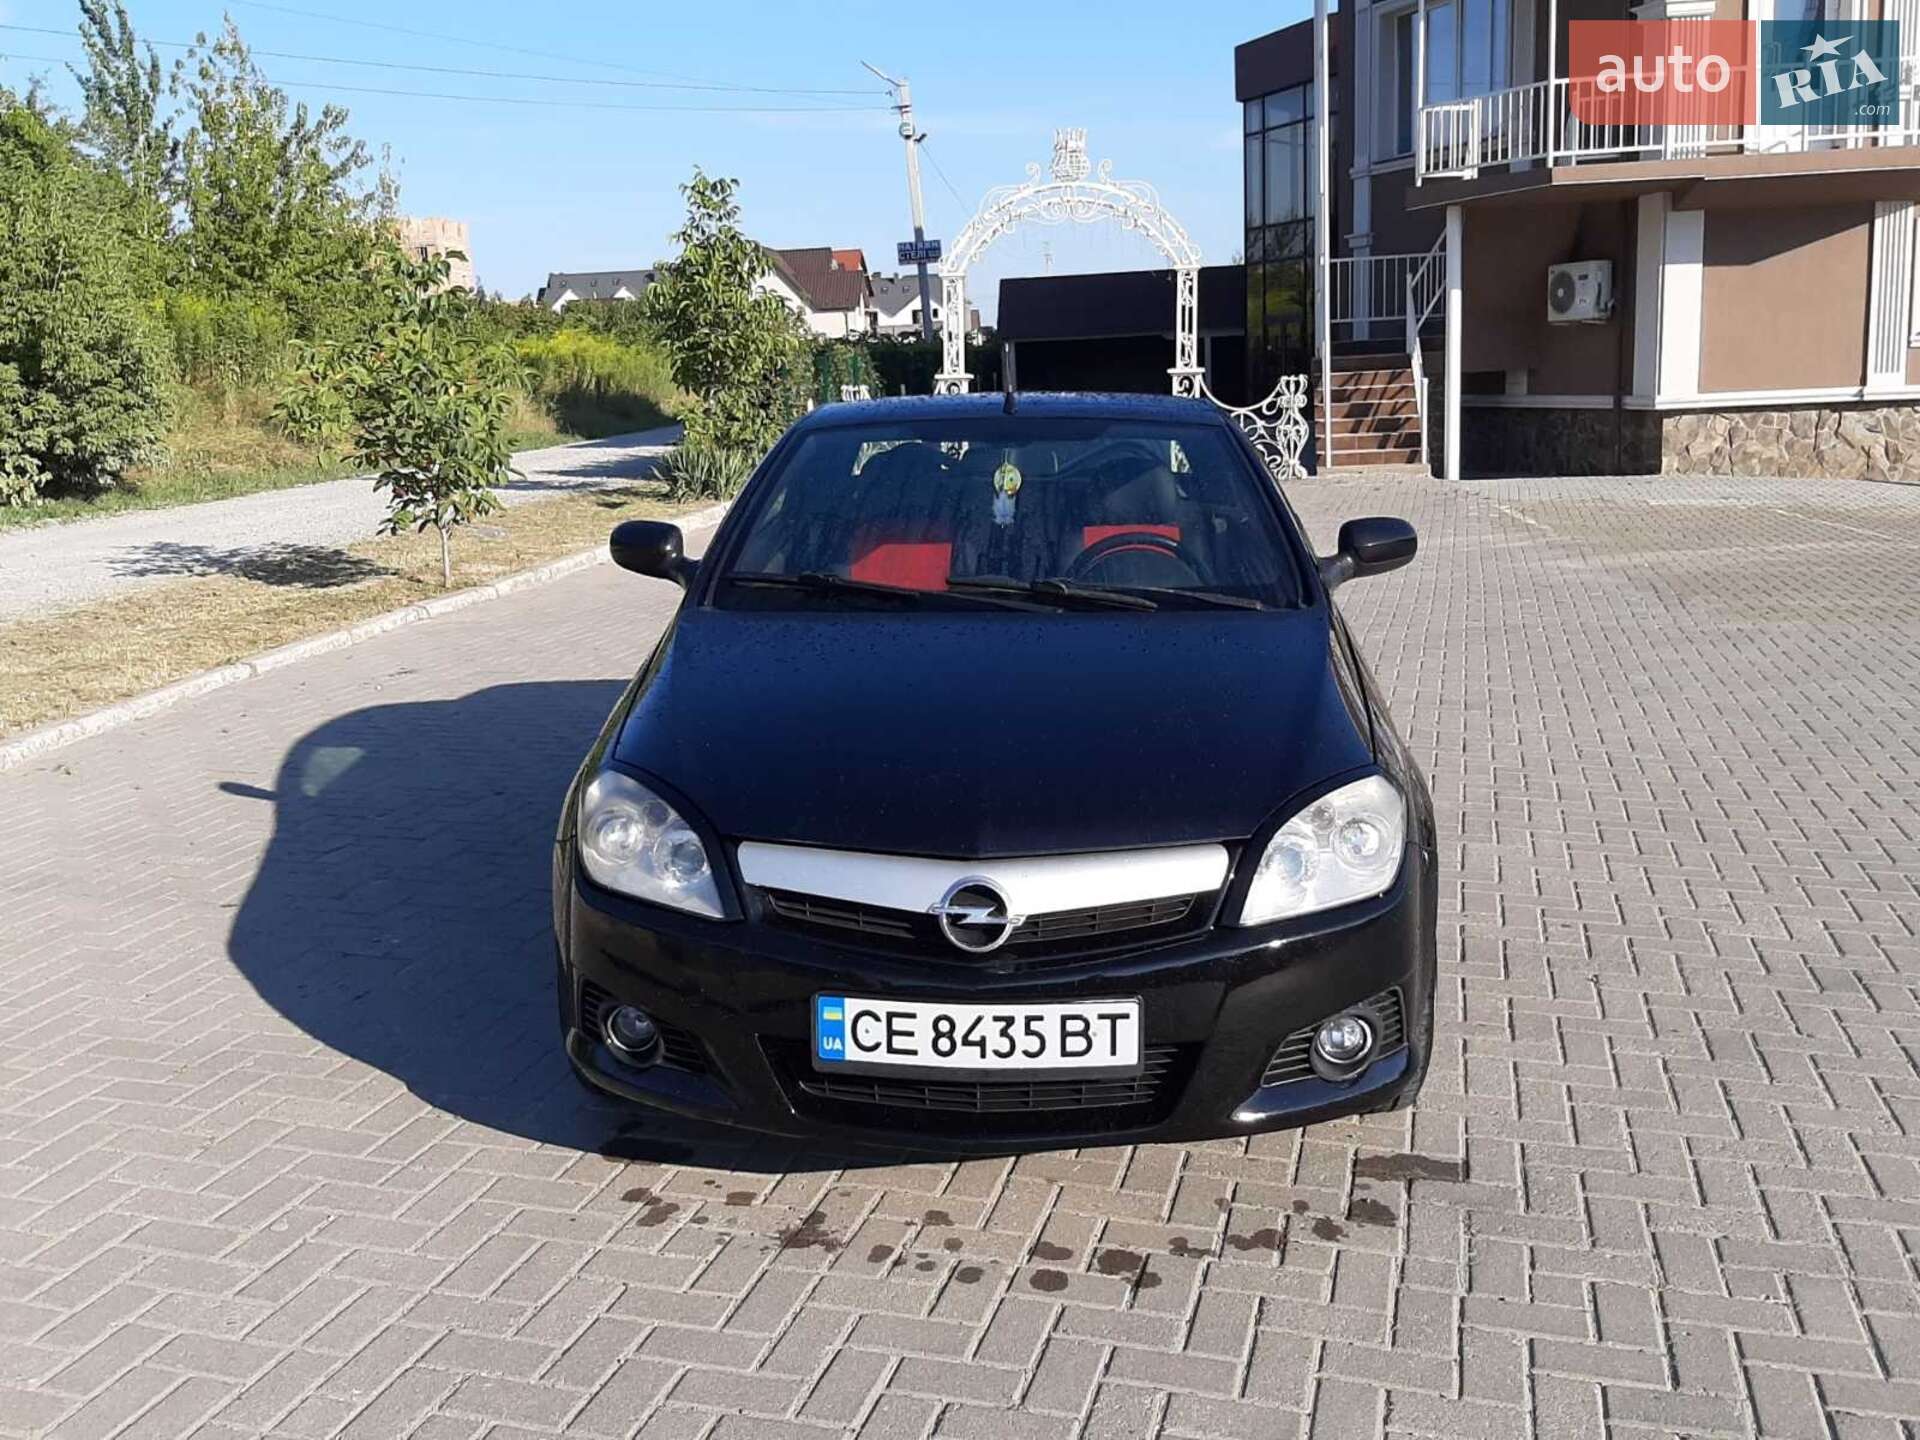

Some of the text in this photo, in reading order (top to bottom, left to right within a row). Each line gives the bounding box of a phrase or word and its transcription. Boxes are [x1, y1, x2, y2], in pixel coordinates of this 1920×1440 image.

[823, 1036, 843, 1050] UA
[851, 1010, 1130, 1058] CE 8435 BT
